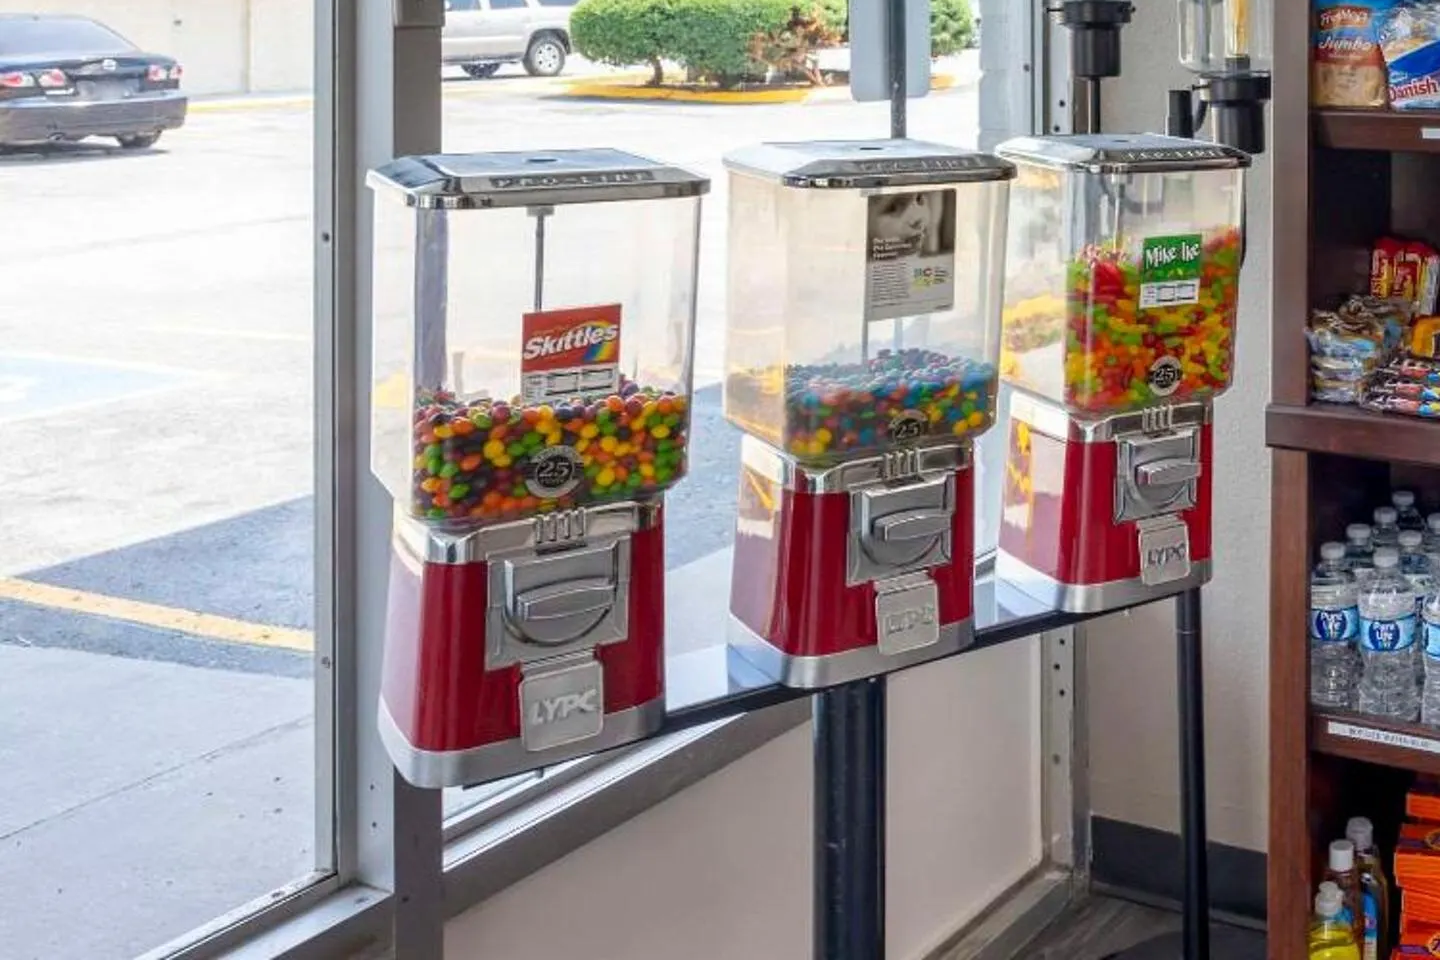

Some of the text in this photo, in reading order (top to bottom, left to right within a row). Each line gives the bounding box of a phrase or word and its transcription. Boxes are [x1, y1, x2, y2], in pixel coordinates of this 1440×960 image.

[1145, 242, 1200, 269] Mike Ike
[523, 324, 618, 360] Skittles
[1156, 366, 1175, 381] 25
[896, 422, 919, 439] 25
[539, 461, 570, 478] 25
[1375, 630, 1394, 642] Life
